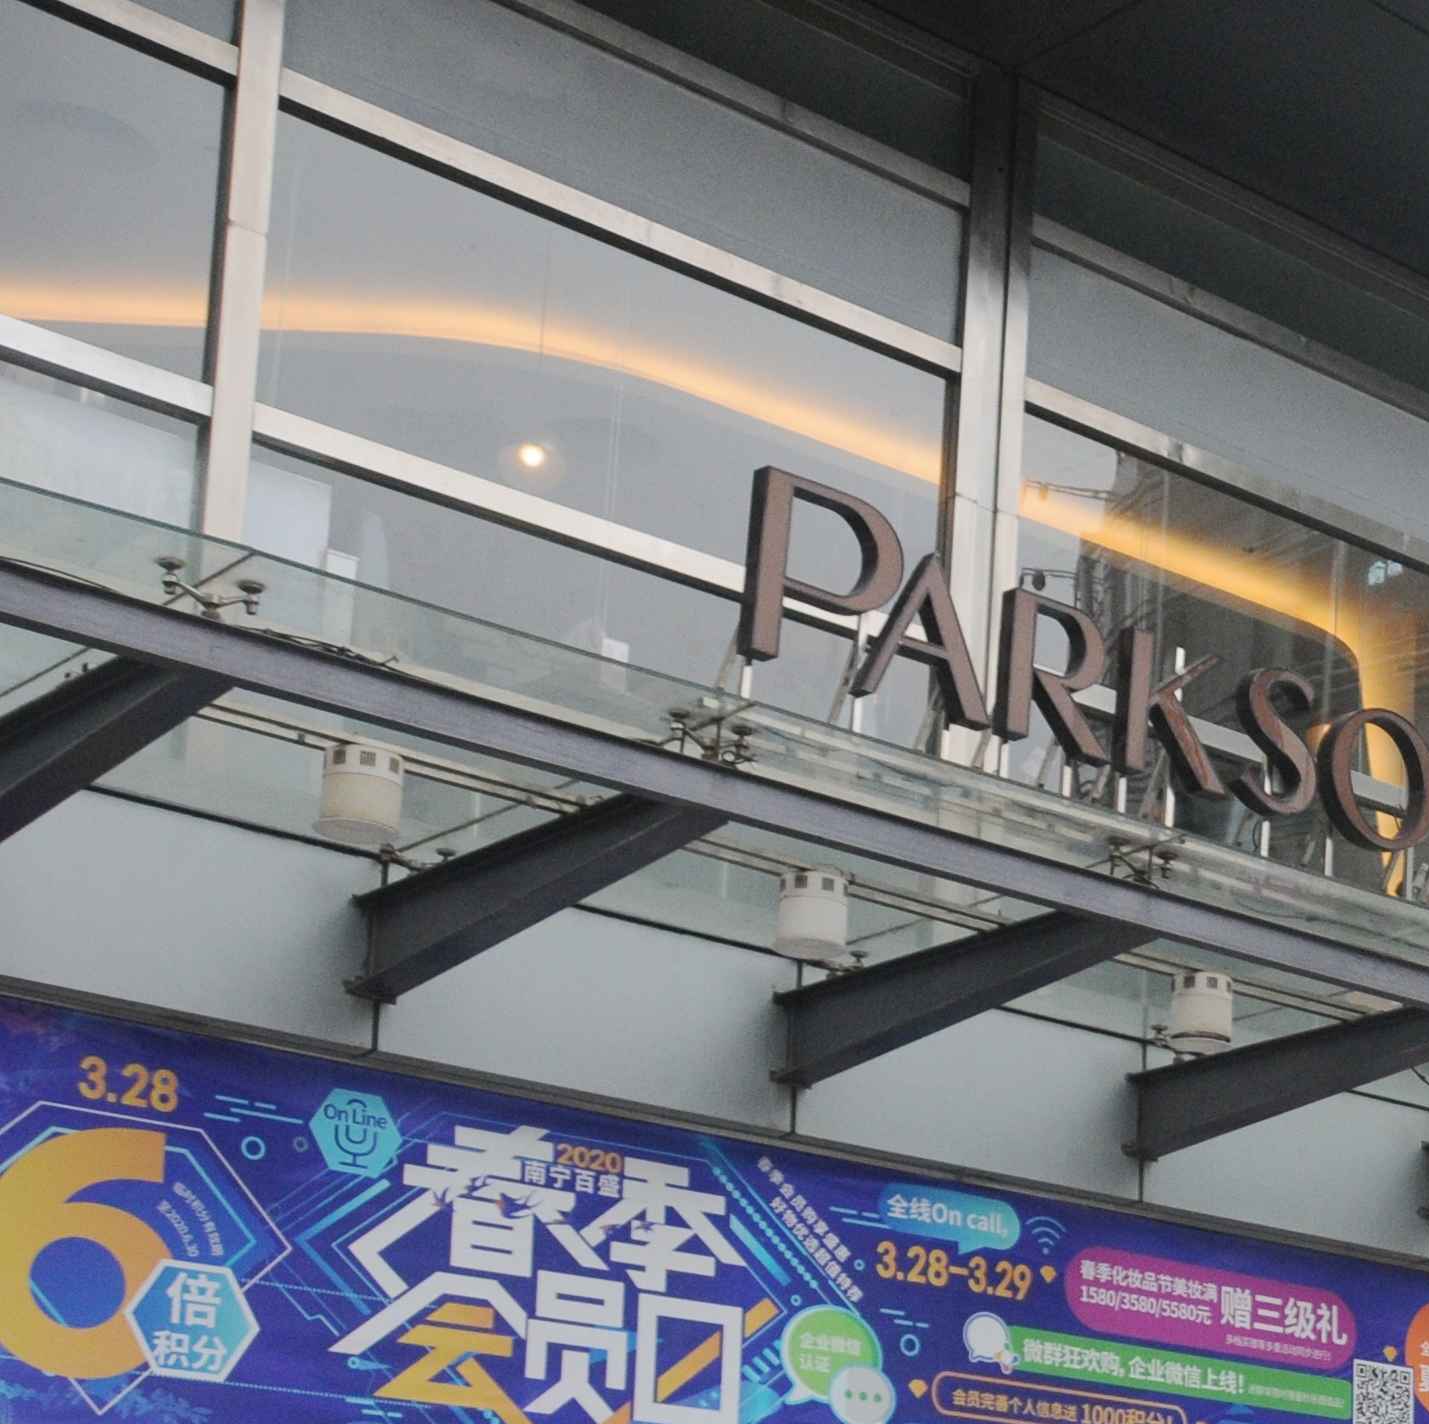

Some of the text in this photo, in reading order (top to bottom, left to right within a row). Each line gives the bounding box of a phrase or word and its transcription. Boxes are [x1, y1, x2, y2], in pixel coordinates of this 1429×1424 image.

[78, 1055, 179, 1113] 3.28
[522, 1160, 624, 1199] 南宁百盛
[556, 1143, 624, 1173] 2020
[166, 1273, 221, 1329] 倍
[1220, 1285, 1348, 1346] 赠三级礼
[151, 1330, 227, 1371] 积分
